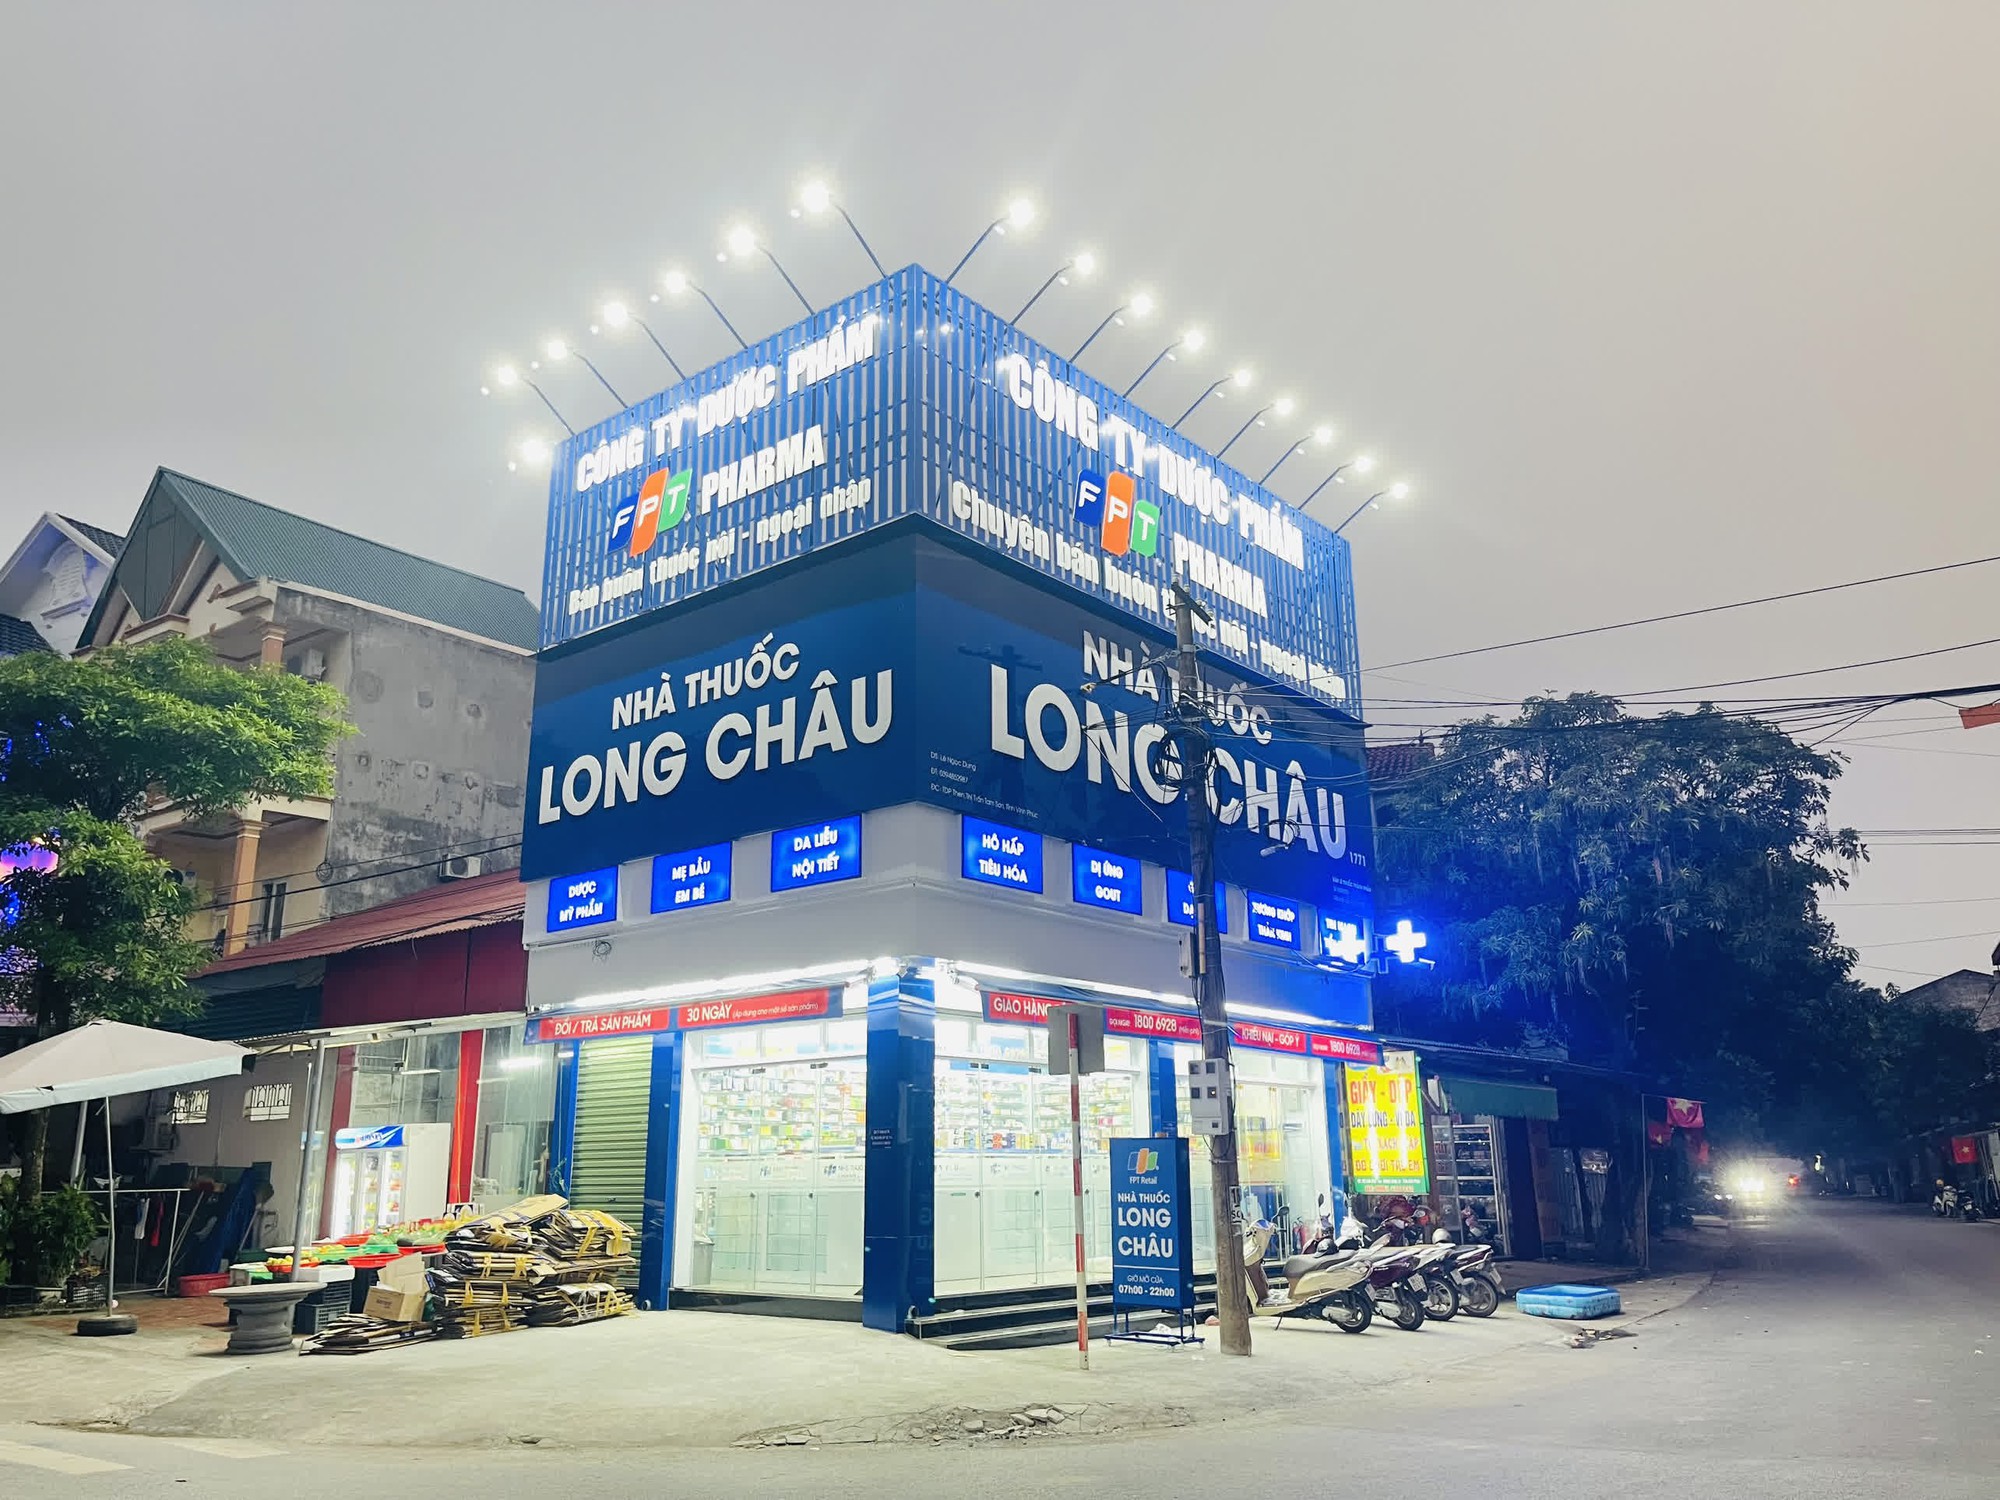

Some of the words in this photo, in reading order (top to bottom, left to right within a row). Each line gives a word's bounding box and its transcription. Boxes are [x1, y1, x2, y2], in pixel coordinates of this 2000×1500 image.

[1007, 354, 1099, 451] CÔNG
[1111, 414, 1148, 477] TY
[576, 434, 645, 492] CÔNG
[651, 409, 687, 457] TY
[701, 424, 827, 515] PHARMA
[953, 480, 1050, 561] Chuyên
[1056, 533, 1099, 586] bán
[1104, 564, 1157, 613] buôn
[1173, 532, 1268, 619] PHARMA
[1083, 631, 1160, 701] NHÀ
[611, 672, 676, 731] NHÀ
[685, 632, 800, 709] THUỐC
[538, 730, 688, 825] LONG
[705, 669, 893, 780] CHÂU
[991, 664, 1182, 804] LONG
[1205, 748, 1347, 860] CHÂU
[794, 836, 811, 851] DA
[982, 833, 999, 850] HÔ
[1002, 836, 1025, 856] HẤP
[672, 866, 687, 882] MẸ
[792, 858, 815, 879] NỘI
[817, 851, 840, 872] TIẾT
[979, 858, 1001, 877] TIÊU
[1003, 864, 1028, 883] HÓA
[675, 888, 691, 904] EM
[1095, 885, 1122, 903] GOUT
[687, 1008, 700, 1022] 30
[701, 1000, 732, 1021] NGÀY
[994, 998, 1021, 1015] GIAO
[572, 1020, 579, 1034] /
[1134, 1013, 1153, 1030] 1800
[1155, 1017, 1177, 1032] 6928
[1280, 1033, 1294, 1046] GÓP
[1389, 1076, 1412, 1103] DP
[1129, 1176, 1140, 1184] FPT
[1141, 1176, 1158, 1185] Retail
[1118, 1191, 1137, 1203] NHÀ
[1139, 1190, 1170, 1204] THUỐC
[1118, 1207, 1171, 1228] LONG
[1118, 1232, 1173, 1258] CHÂU
[1118, 1284, 1143, 1296] 07h00
[1150, 1286, 1175, 1298] 22h00
